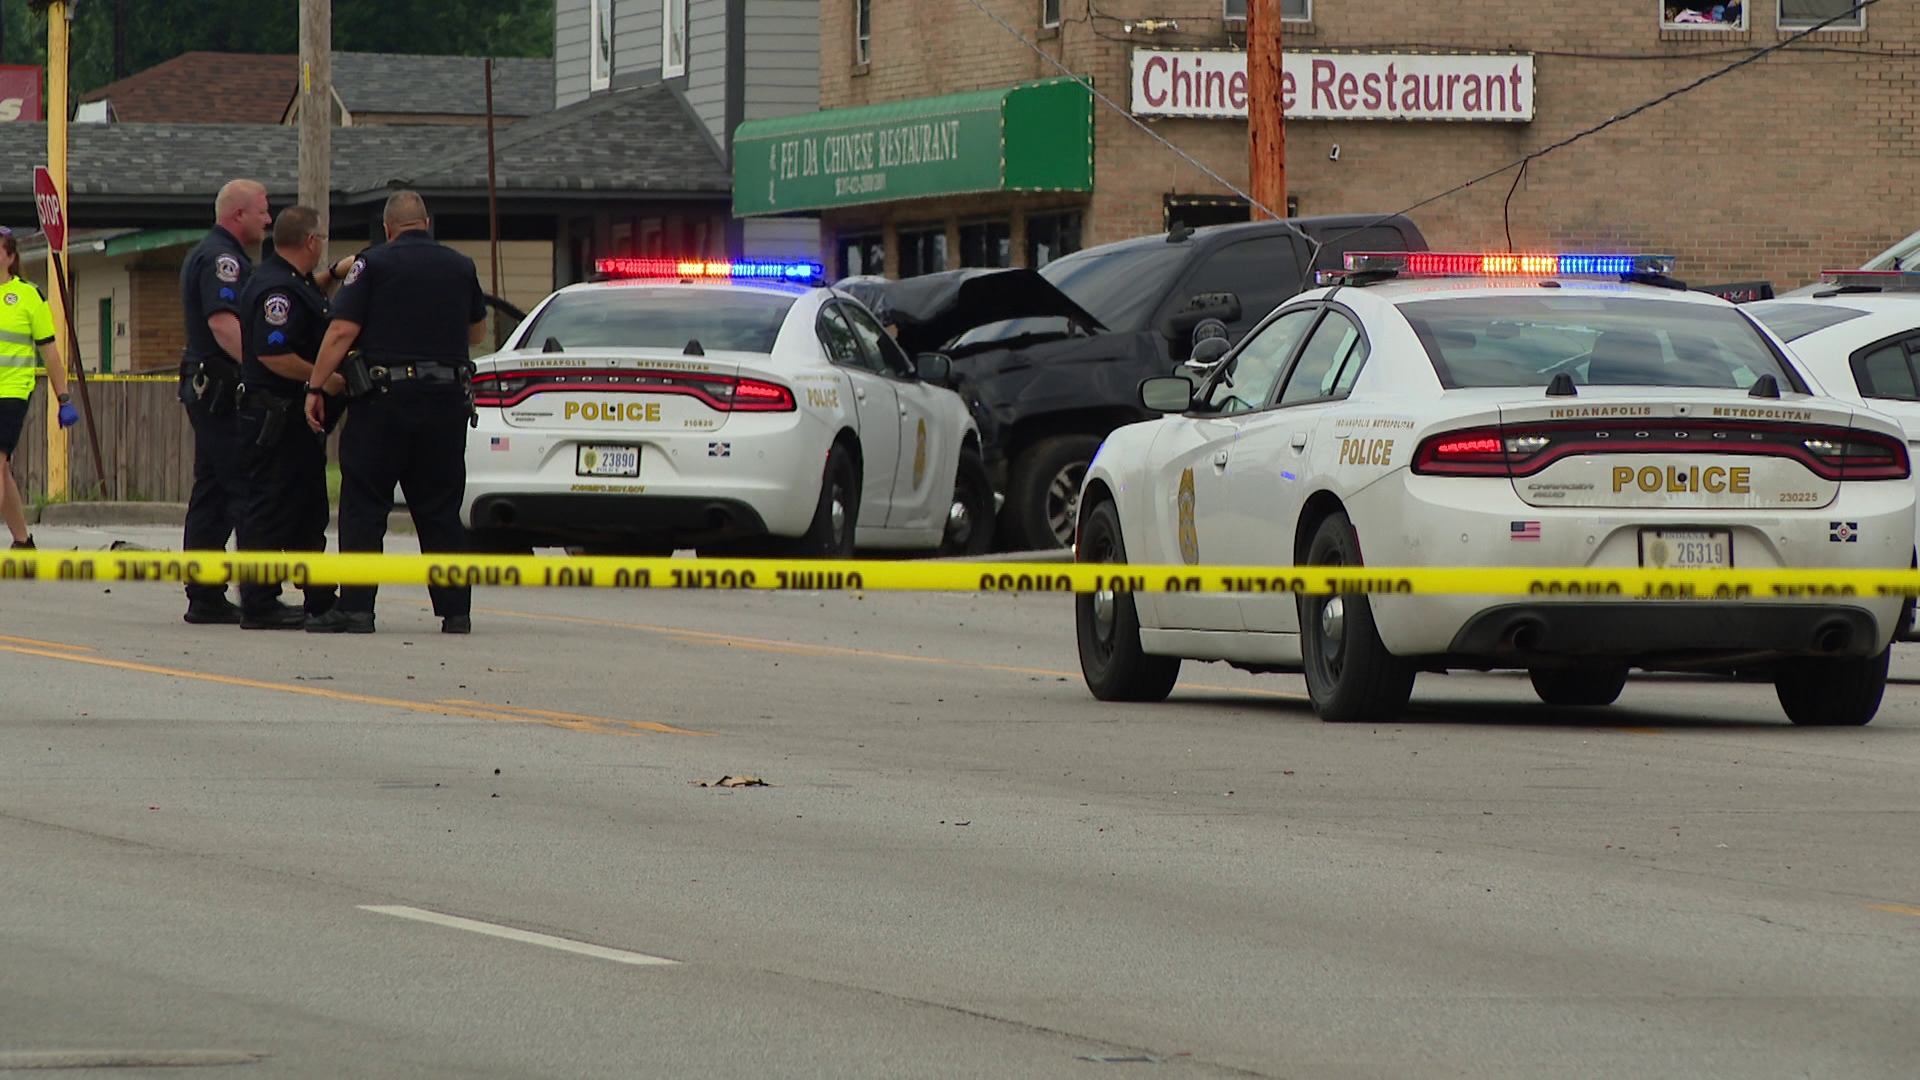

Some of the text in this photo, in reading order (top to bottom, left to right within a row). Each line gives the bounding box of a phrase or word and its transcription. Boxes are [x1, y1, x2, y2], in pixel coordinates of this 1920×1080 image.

[1142, 55, 1523, 113] Chinee Restaurant
[780, 140, 799, 180] FEI
[802, 138, 819, 176] DA
[823, 131, 874, 175] CHINESE
[878, 120, 960, 168] RESTAURANT
[36, 194, 60, 226] STOP
[519, 359, 710, 371] INDIANAPOLIS METROPOLITAN
[807, 388, 840, 408] POLICE
[564, 401, 662, 422] POLICE
[1550, 407, 1812, 420] INDIANAPOLIS METROPOLITAN
[1372, 419, 1415, 429] METROPOLITAN
[1595, 431, 1764, 440] DODGE
[602, 452, 635, 468] 23890
[1338, 439, 1395, 466] POLICE
[1612, 466, 1751, 494] POLICE
[1779, 493, 1819, 502] 230225
[1664, 532, 1706, 540] INDIANA
[1677, 542, 1723, 564] 26319
